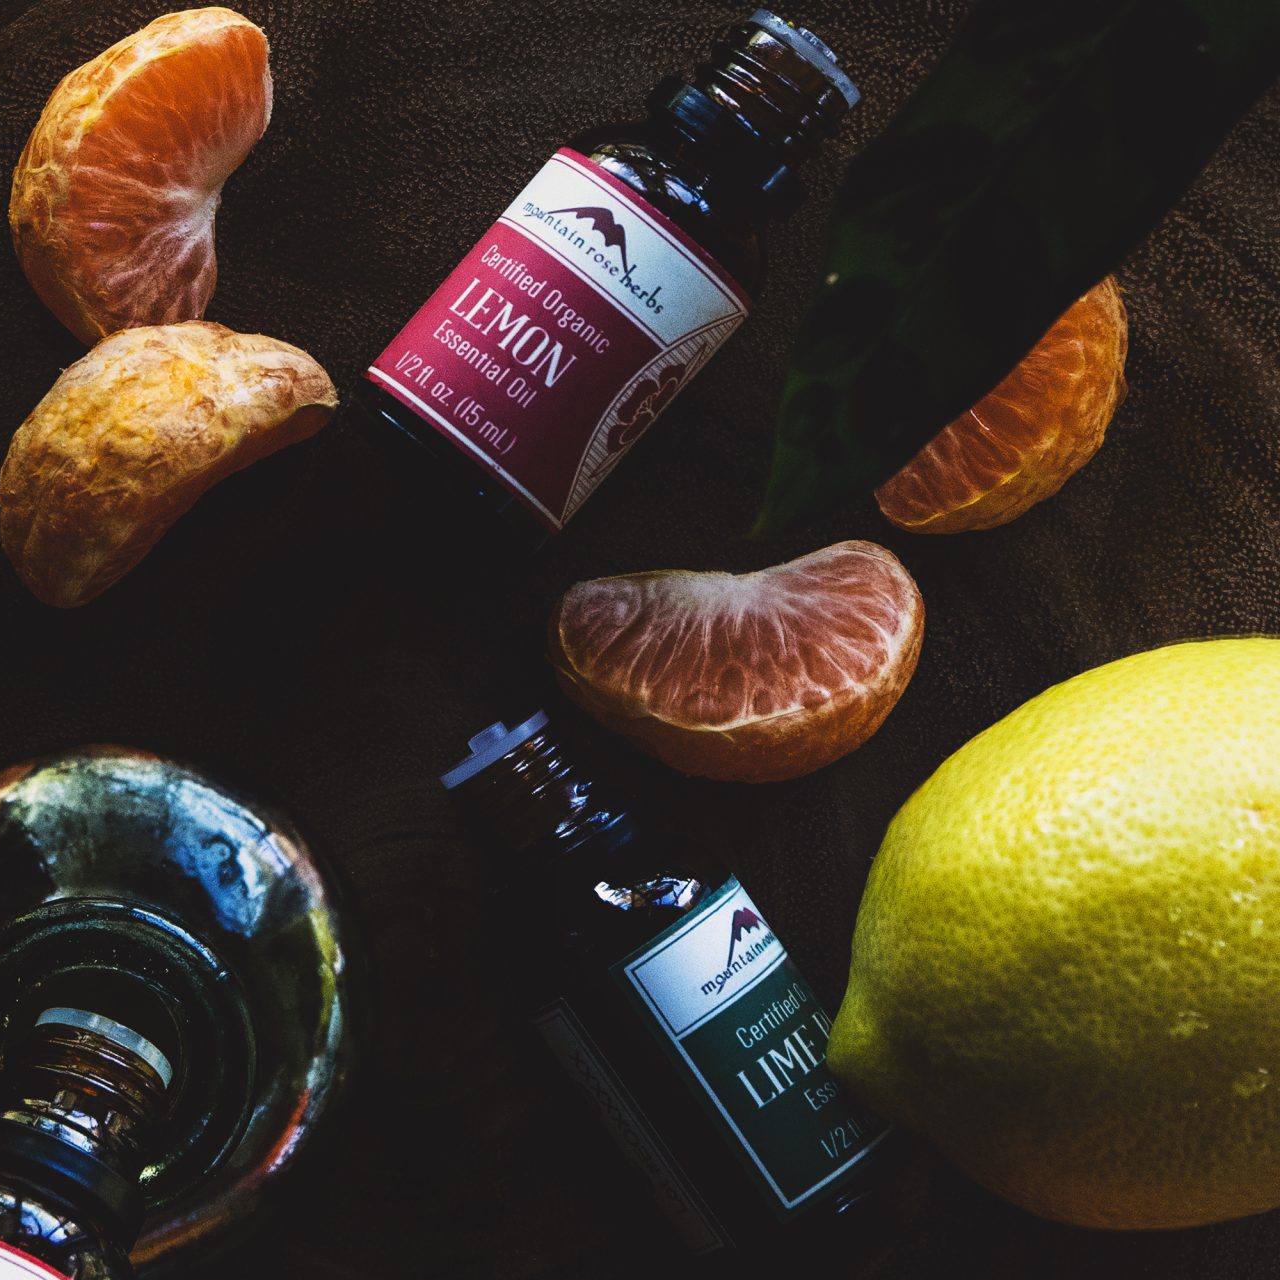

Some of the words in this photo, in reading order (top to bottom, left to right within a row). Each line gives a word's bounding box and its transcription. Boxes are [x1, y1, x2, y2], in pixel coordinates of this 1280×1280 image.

[481, 244, 547, 299] Certified
[542, 289, 611, 354] Organic
[523, 201, 586, 249] mountain
[586, 246, 619, 276] rose
[619, 264, 664, 315] herbs
[433, 319, 509, 385] Essential
[506, 377, 537, 409] Oil
[449, 277, 578, 388] LEMON
[430, 381, 455, 407] oz.
[453, 395, 486, 427] (15
[478, 420, 518, 455] mL)
[701, 942, 765, 995] mountain
[735, 988, 800, 1049] Certified
[736, 1024, 827, 1109] LIME
